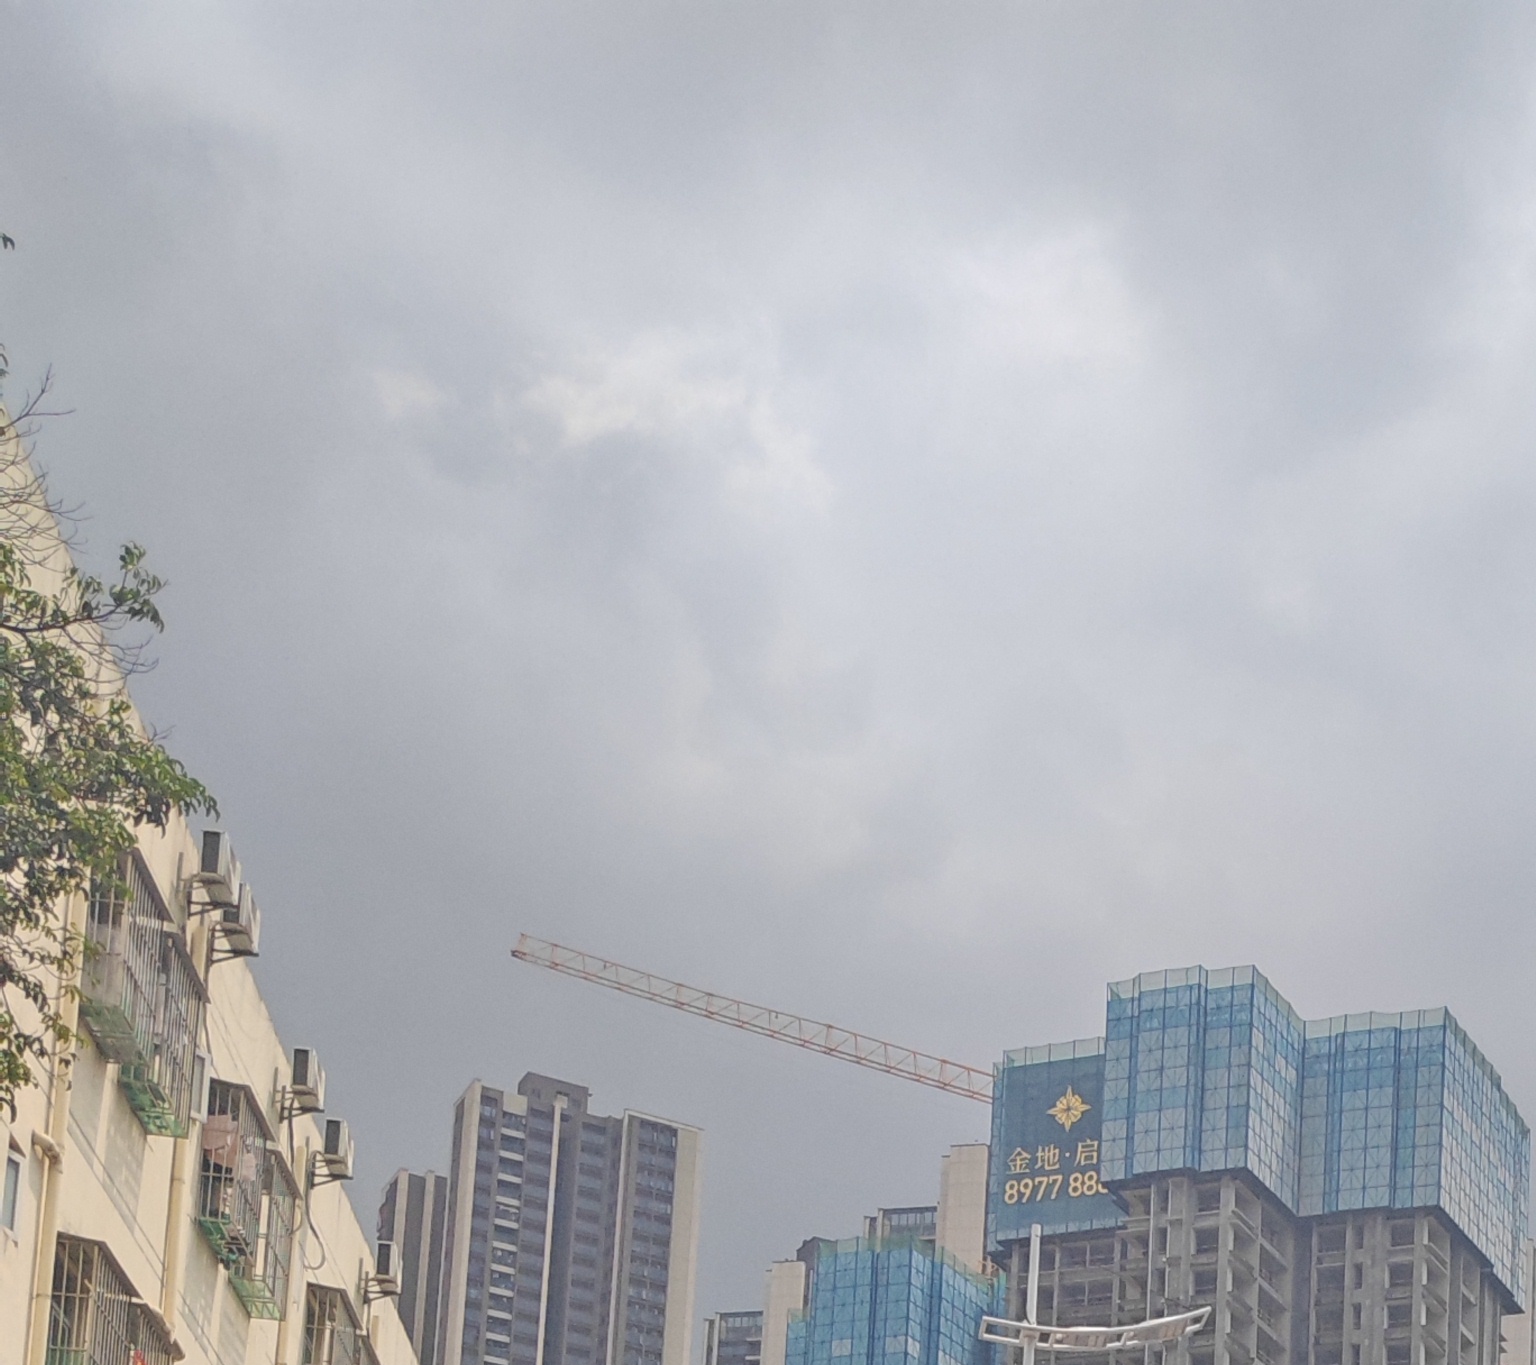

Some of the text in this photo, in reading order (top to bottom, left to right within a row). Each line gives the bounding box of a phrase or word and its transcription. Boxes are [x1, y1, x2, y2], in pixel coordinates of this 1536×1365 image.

[1006, 1138, 1099, 1175] 金地·启
[1004, 1174, 1063, 1205] 8977
